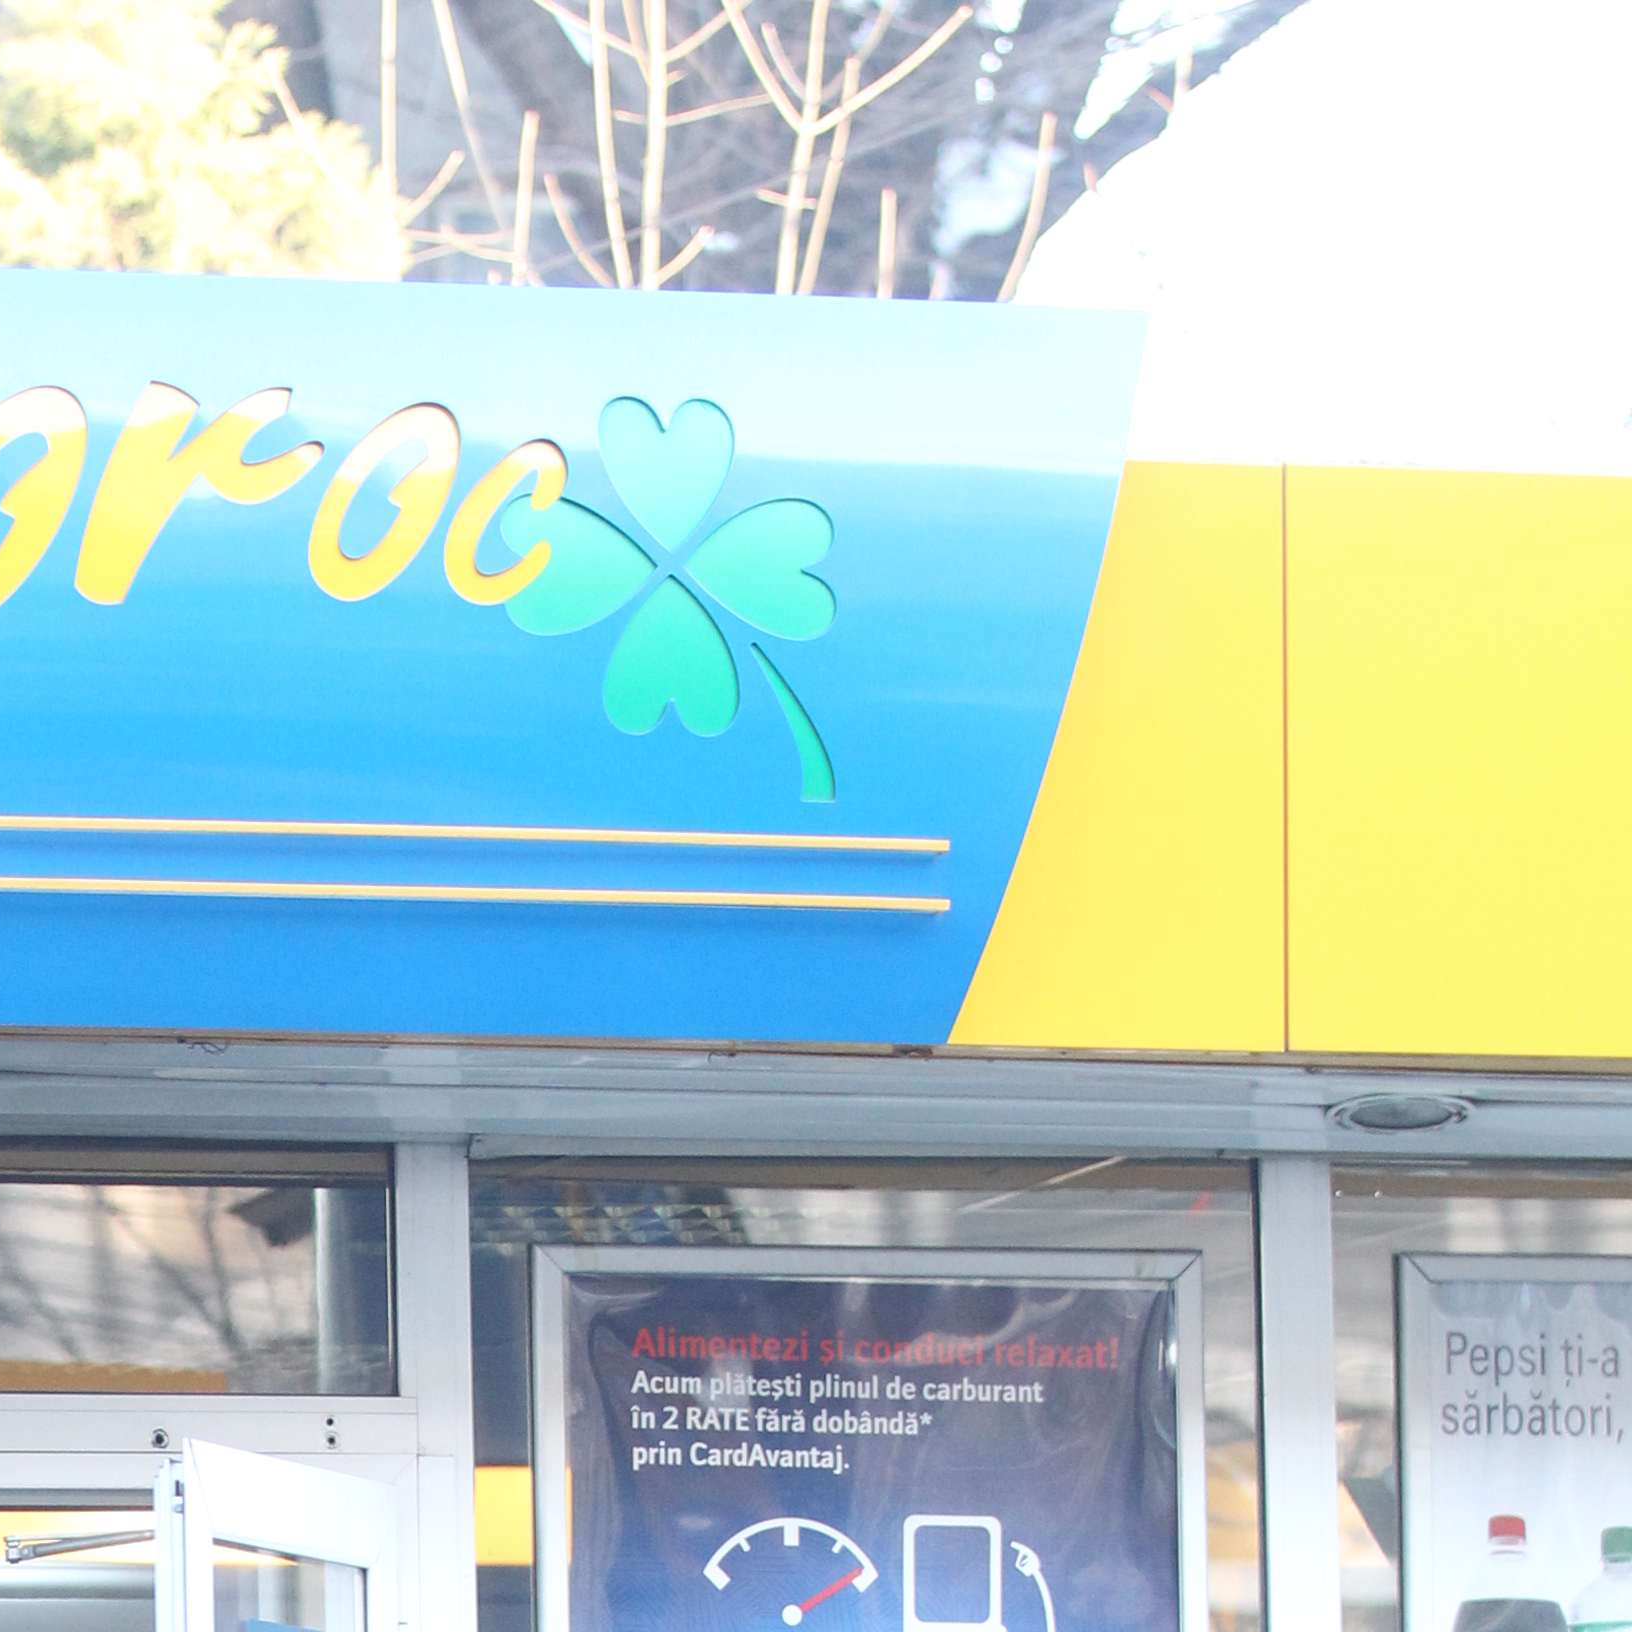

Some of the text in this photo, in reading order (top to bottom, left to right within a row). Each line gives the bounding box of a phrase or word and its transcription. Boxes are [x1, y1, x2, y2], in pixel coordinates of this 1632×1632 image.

[632, 1325, 808, 1362] Alimentezi
[854, 1331, 983, 1366] conduci
[996, 1335, 1118, 1370] relaxat!
[1444, 1331, 1547, 1387] Pepsi
[631, 1370, 702, 1394] Acum
[809, 1373, 879, 1404] plinul
[886, 1376, 916, 1400] de
[923, 1377, 1044, 1403] carburant
[630, 1405, 656, 1429] în
[662, 1407, 679, 1430] 2
[686, 1407, 750, 1431] RATE
[755, 1407, 806, 1433] fără
[1440, 1394, 1625, 1446] sărbători,
[632, 1441, 850, 1474] prin CardAvantaj.
